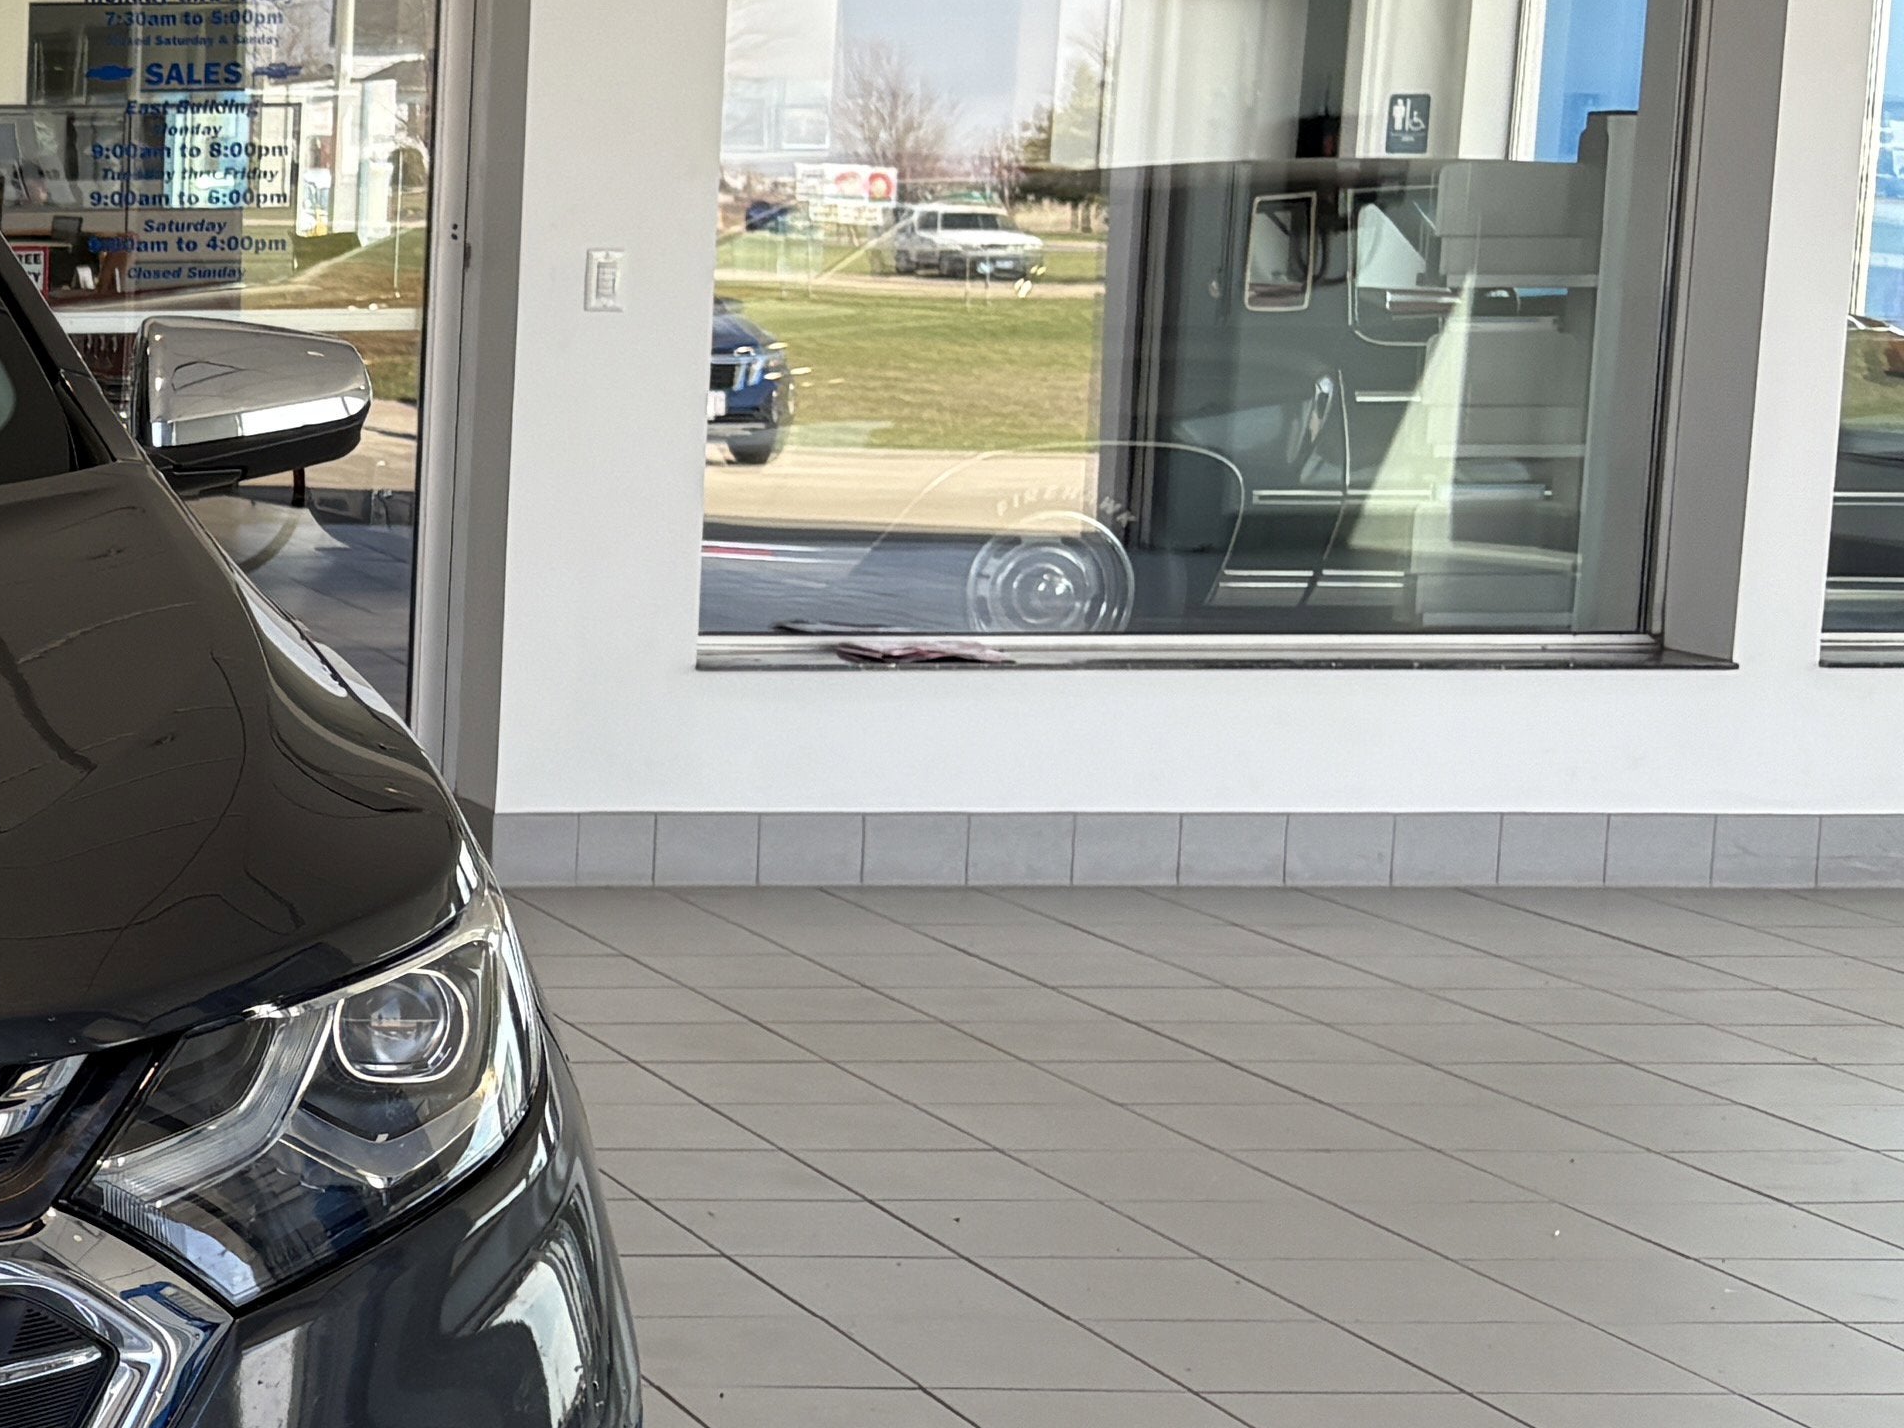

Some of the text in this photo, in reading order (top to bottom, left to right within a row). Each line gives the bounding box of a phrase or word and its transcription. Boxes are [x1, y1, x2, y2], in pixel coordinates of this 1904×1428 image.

[105, 9, 284, 30] 7:30am to 5:00pm
[155, 34, 214, 49] Saturday
[145, 62, 242, 86] SALES
[126, 98, 261, 119] East Building
[155, 123, 223, 138] onday
[91, 141, 288, 163] 9:00am to 8:00pm
[102, 167, 175, 184] Tueay
[223, 167, 279, 183] Friday
[89, 190, 288, 211] 9:00am to 6:00pm
[144, 219, 227, 237] Saturday
[88, 235, 287, 254] 0am to 4:00pm
[127, 265, 247, 284] Closed Sunday
[995, 484, 1137, 530] FIREHWK
